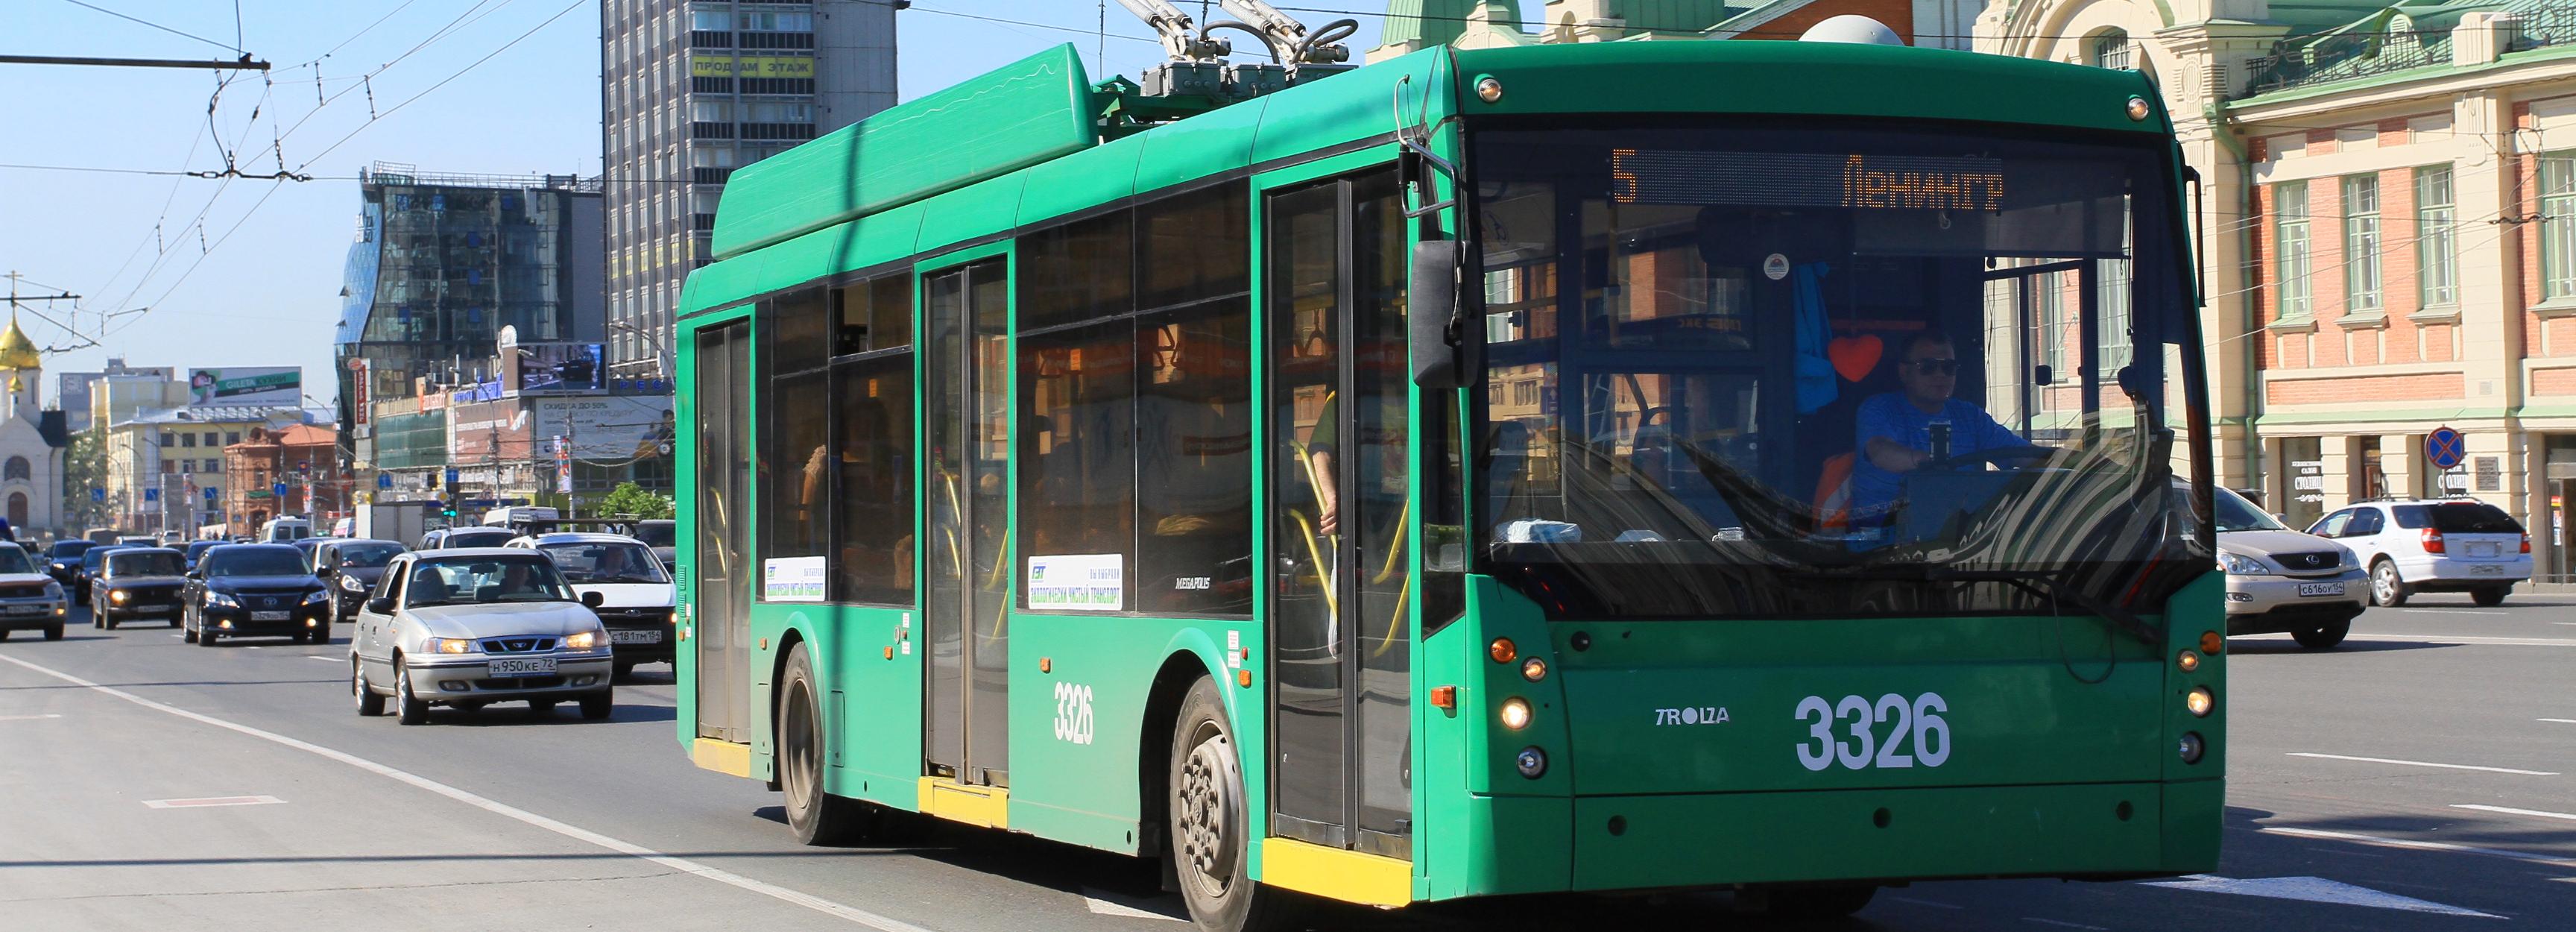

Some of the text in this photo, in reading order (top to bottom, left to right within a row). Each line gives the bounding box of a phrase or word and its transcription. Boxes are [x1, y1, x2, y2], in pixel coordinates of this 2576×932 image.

[695, 62, 809, 72] ПРОДАМ ЭТАЖ
[1614, 149, 1636, 202] 5
[1842, 154, 2003, 210] Ленингр
[1175, 577, 1210, 589] MEGAPOLIS
[1031, 584, 1120, 604] ЭКОЛОГИЧЕСКИ ЧИСТЫЙ ТРАНСПОРТ
[493, 659, 553, 672] Н950КЕ 72
[1055, 681, 1093, 745] 3326
[1655, 707, 1730, 725] TROLZA
[1795, 692, 1950, 771] 3326
